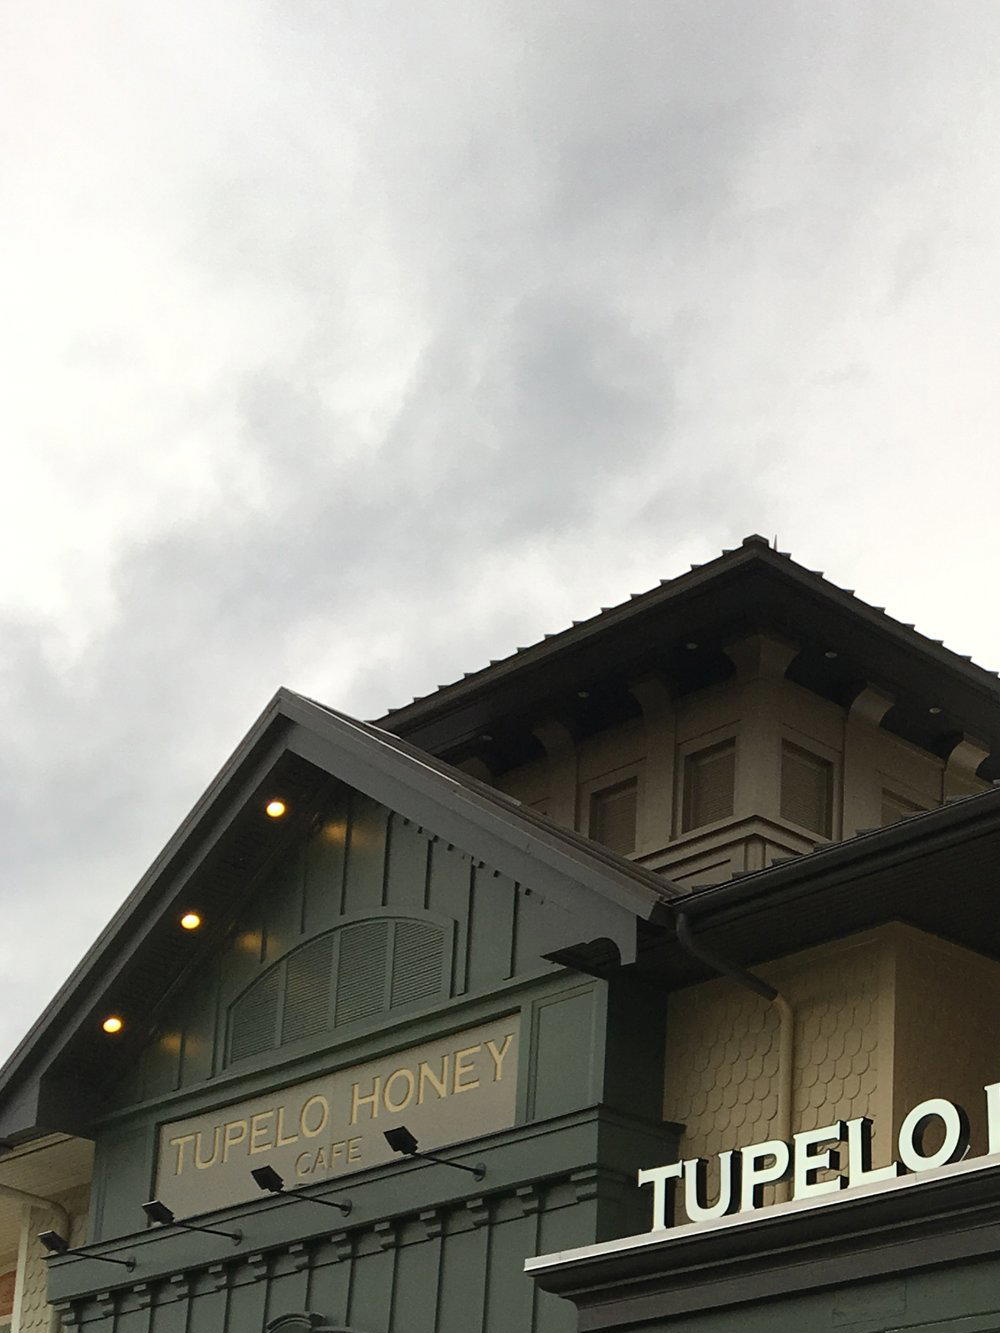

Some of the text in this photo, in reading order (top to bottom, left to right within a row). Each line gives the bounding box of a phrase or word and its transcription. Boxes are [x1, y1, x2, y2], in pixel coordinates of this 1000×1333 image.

[168, 1033, 515, 1176] TUPELO HONEY
[294, 1135, 363, 1178] CAFE
[637, 1098, 963, 1233] TUPELO
